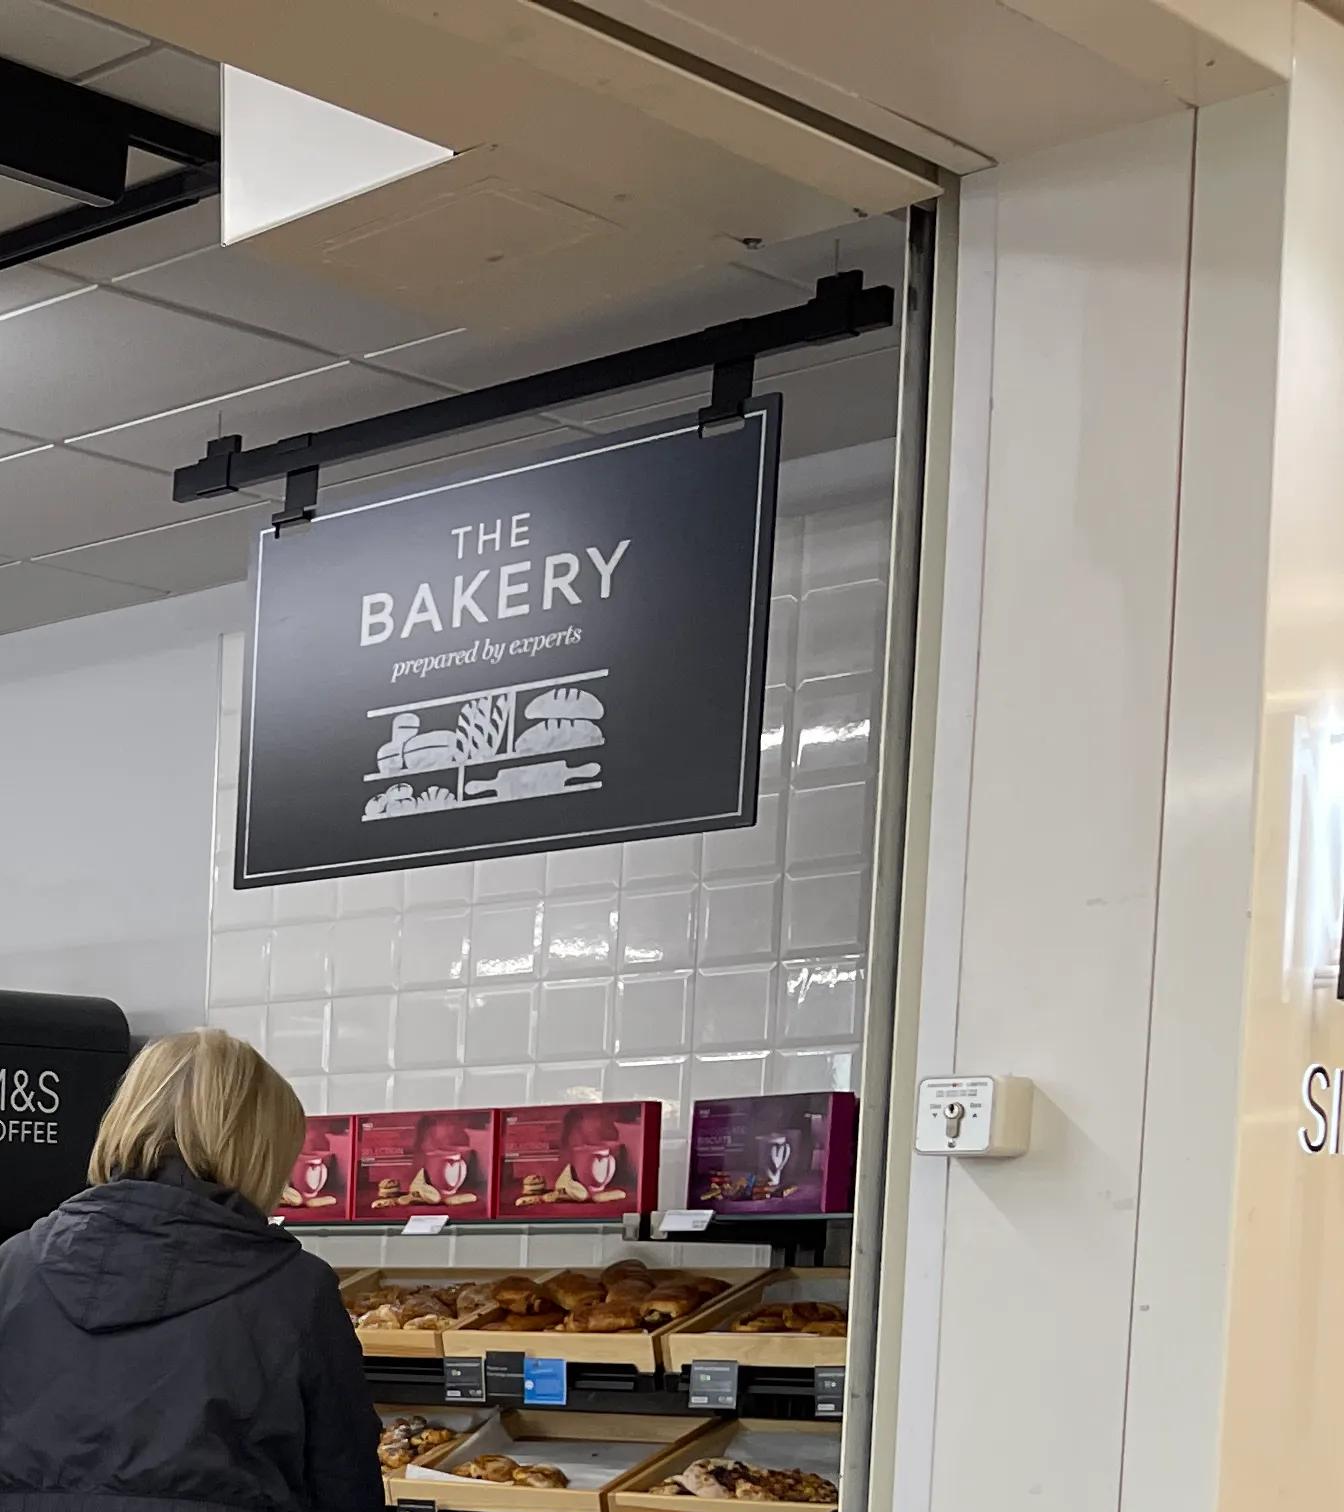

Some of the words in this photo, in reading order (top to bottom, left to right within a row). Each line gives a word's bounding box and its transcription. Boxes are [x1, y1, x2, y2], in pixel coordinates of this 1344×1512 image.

[451, 512, 531, 560] THE
[359, 539, 632, 648] BAKERY
[391, 640, 479, 683] prepared
[482, 639, 506, 664] by
[509, 625, 583, 657] experts
